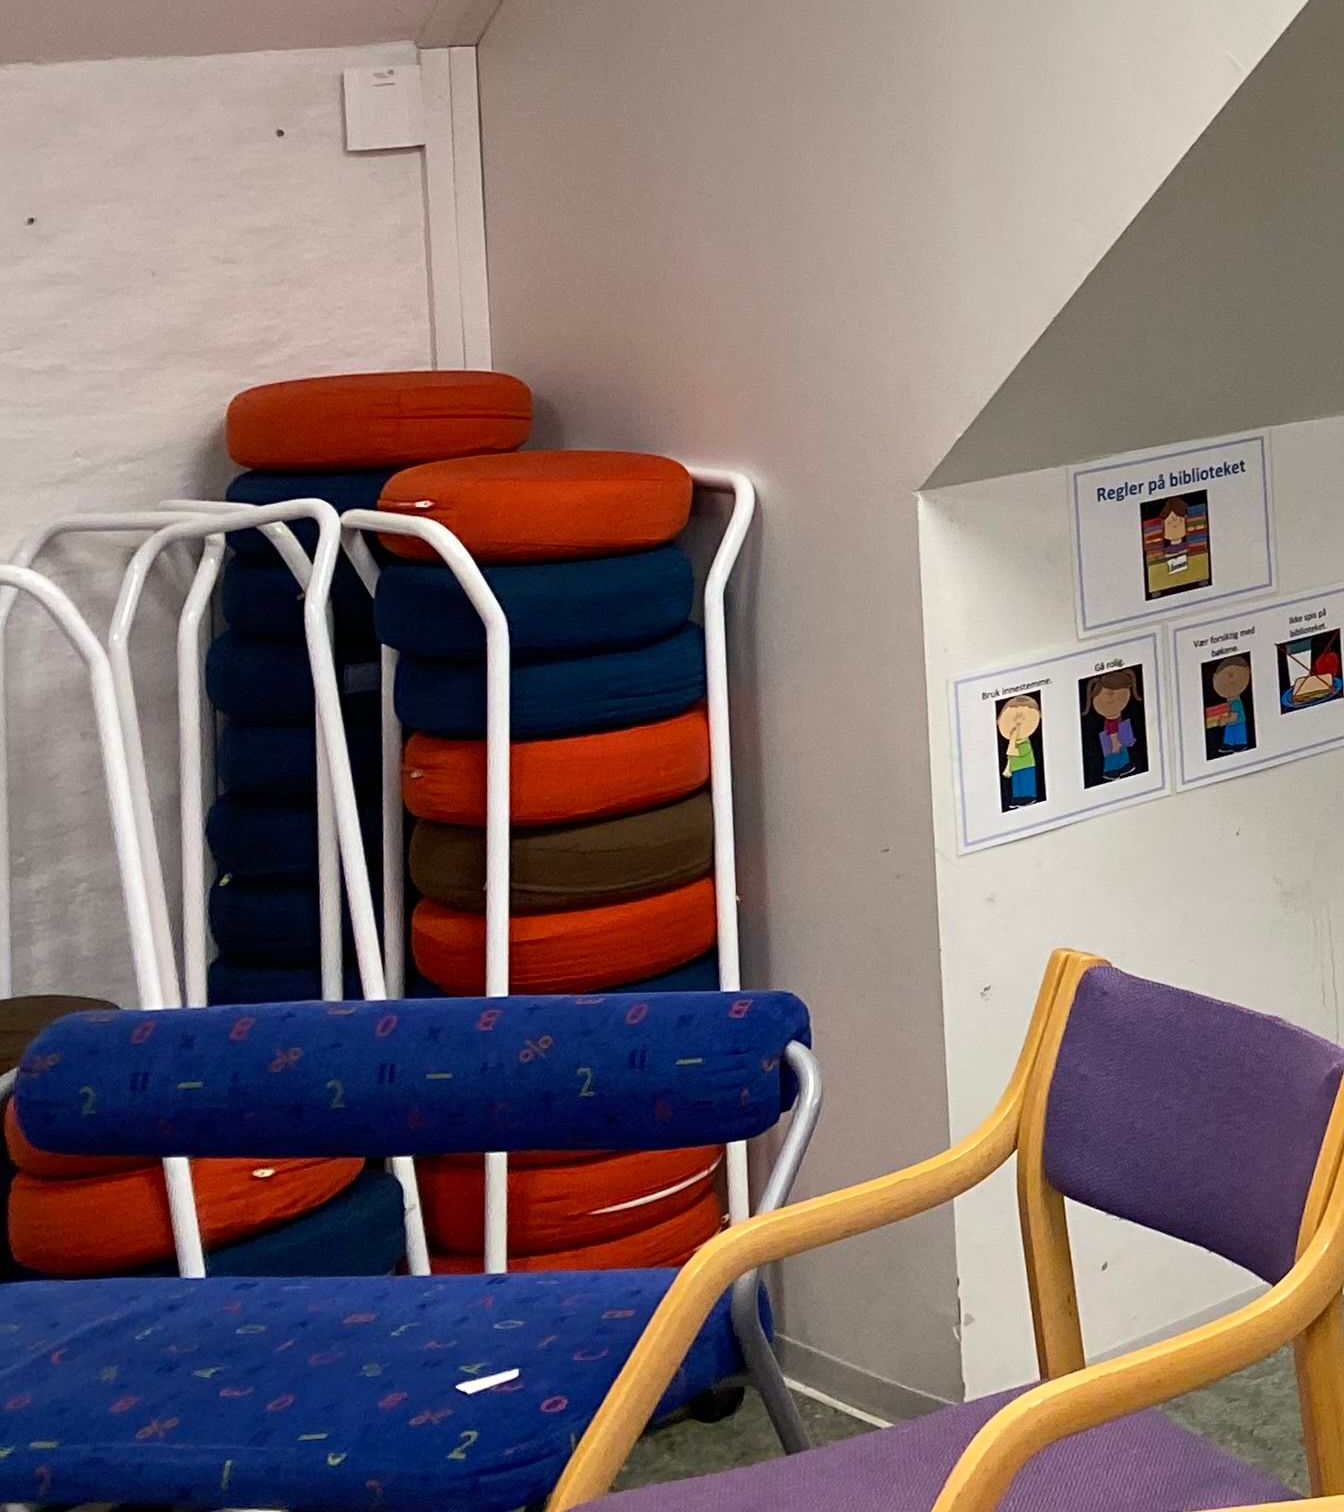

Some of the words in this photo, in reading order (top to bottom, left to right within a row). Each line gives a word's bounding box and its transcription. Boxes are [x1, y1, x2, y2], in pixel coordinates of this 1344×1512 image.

[1096, 481, 1144, 503] Regler
[1148, 474, 1166, 495] på
[1169, 460, 1247, 487] biblioteket
[1289, 614, 1303, 625] Ikke
[1318, 608, 1327, 618] på
[1193, 638, 1209, 648] Vær
[1210, 631, 1239, 644] forsiktig
[1239, 626, 1256, 637] med
[1094, 660, 1105, 672] Gå
[982, 688, 1001, 700] Bruk
